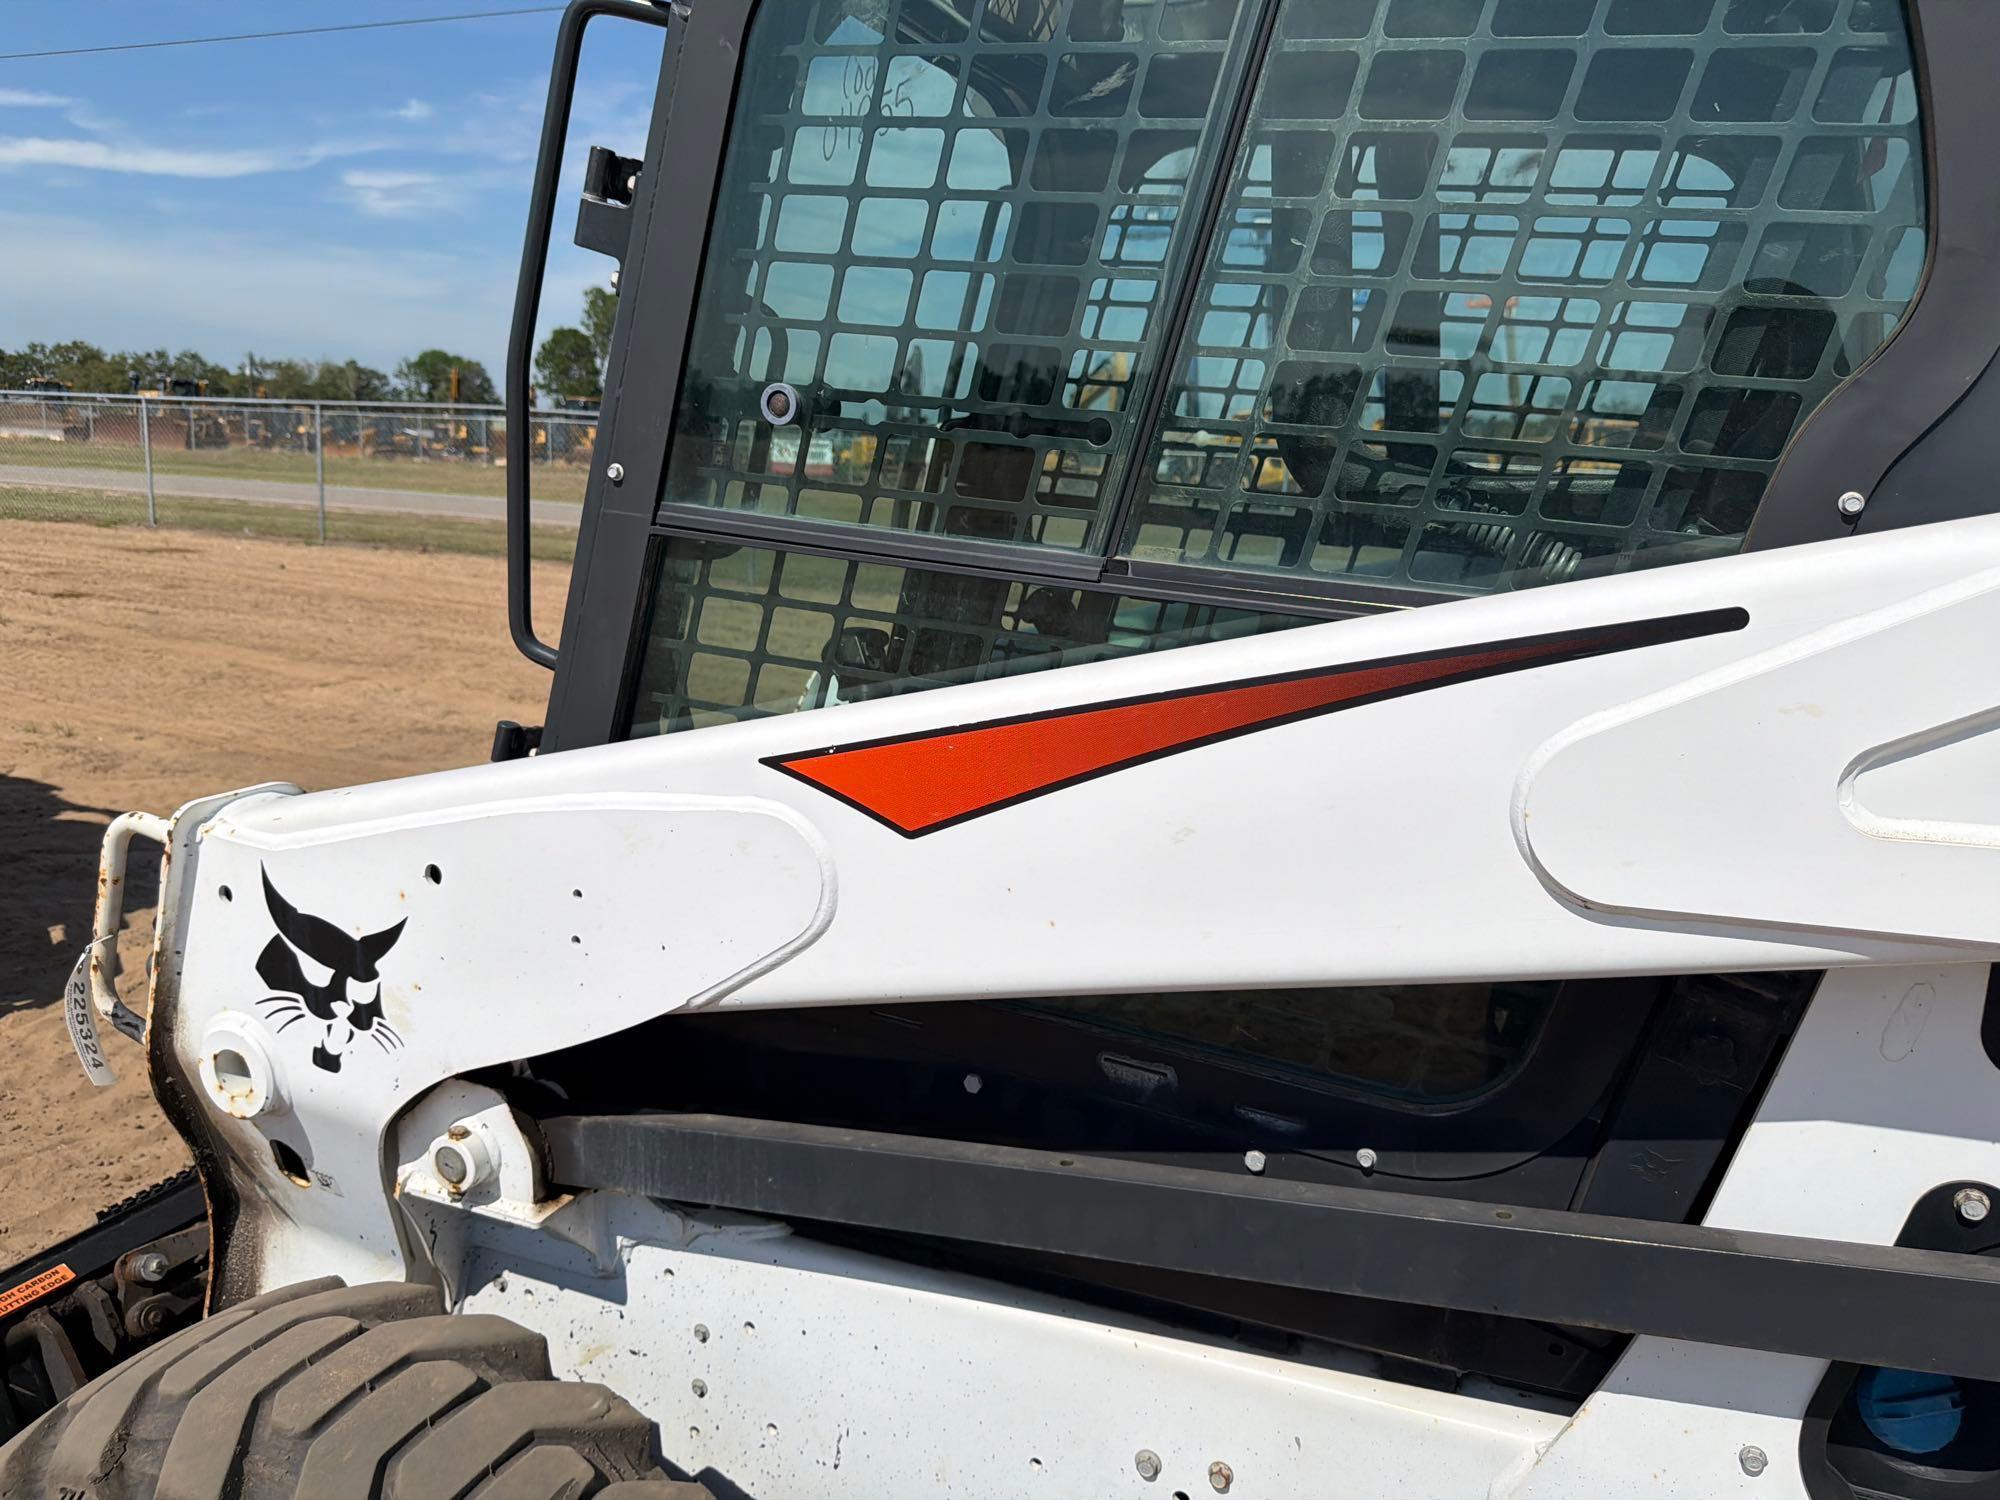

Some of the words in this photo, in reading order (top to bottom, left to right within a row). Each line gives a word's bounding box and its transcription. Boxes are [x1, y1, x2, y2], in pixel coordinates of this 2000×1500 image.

[73, 982, 104, 1069] 225324
[0, 1292, 16, 1303] GH
[17, 1269, 60, 1293] CARBON
[0, 1290, 40, 1314] UTTING
[41, 1274, 69, 1291] EDGE
